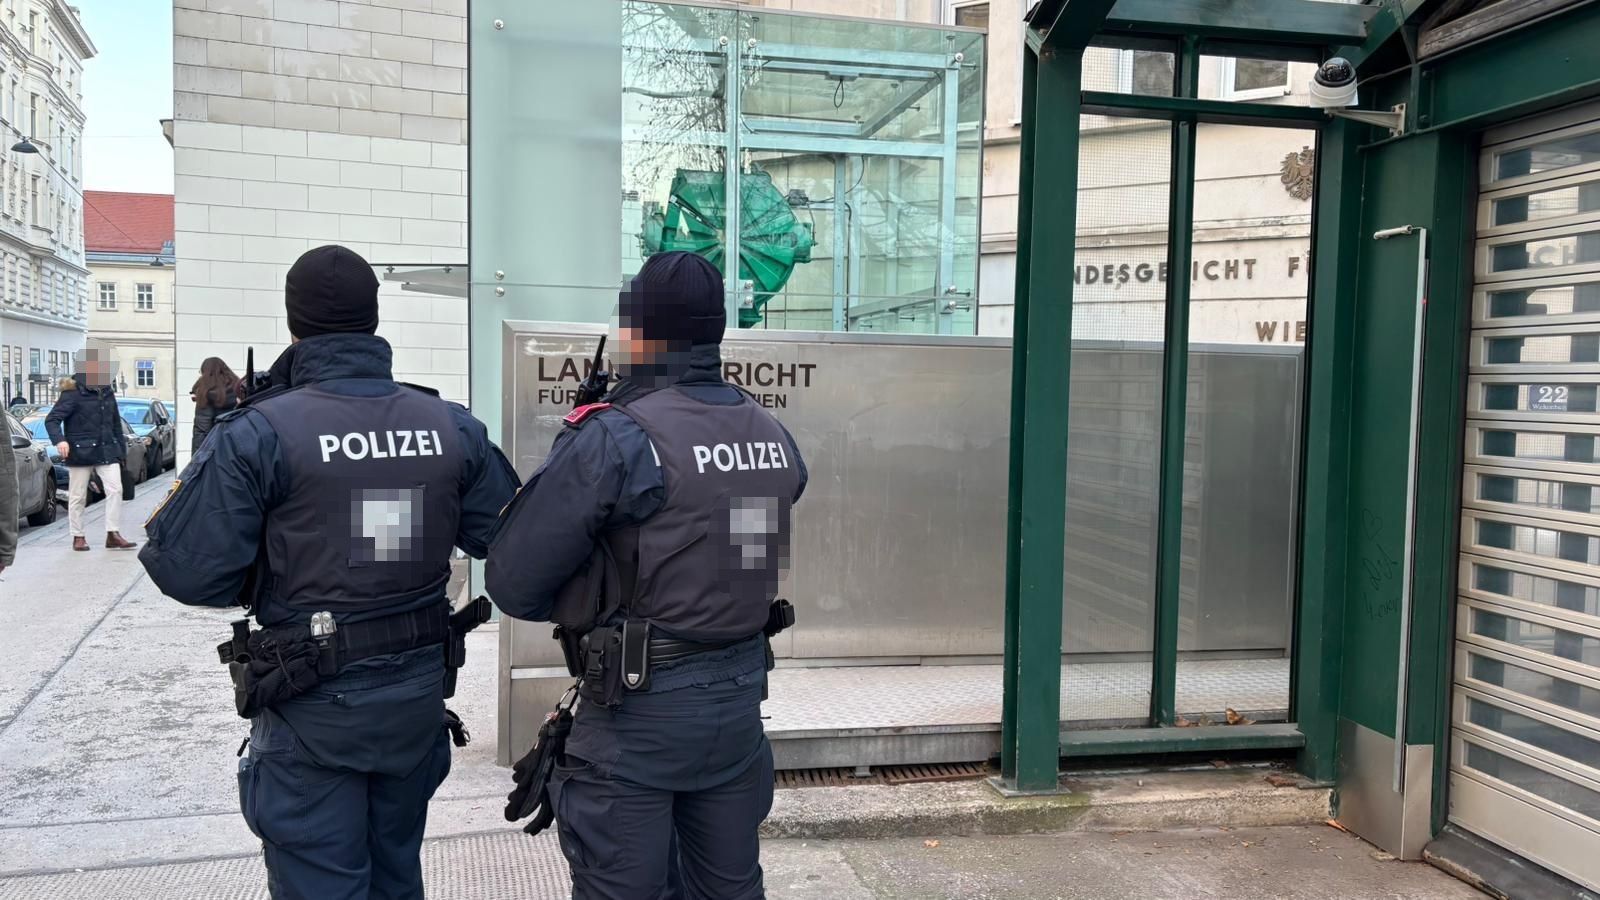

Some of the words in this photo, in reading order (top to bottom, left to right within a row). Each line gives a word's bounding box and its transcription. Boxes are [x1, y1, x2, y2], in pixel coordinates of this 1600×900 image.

[1075, 258, 1257, 285] DESGEICHT
[1256, 321, 1306, 342] WIE
[1538, 386, 1568, 403] 22
[318, 430, 443, 462] POLIZEI
[692, 442, 789, 473] POLIZEI
